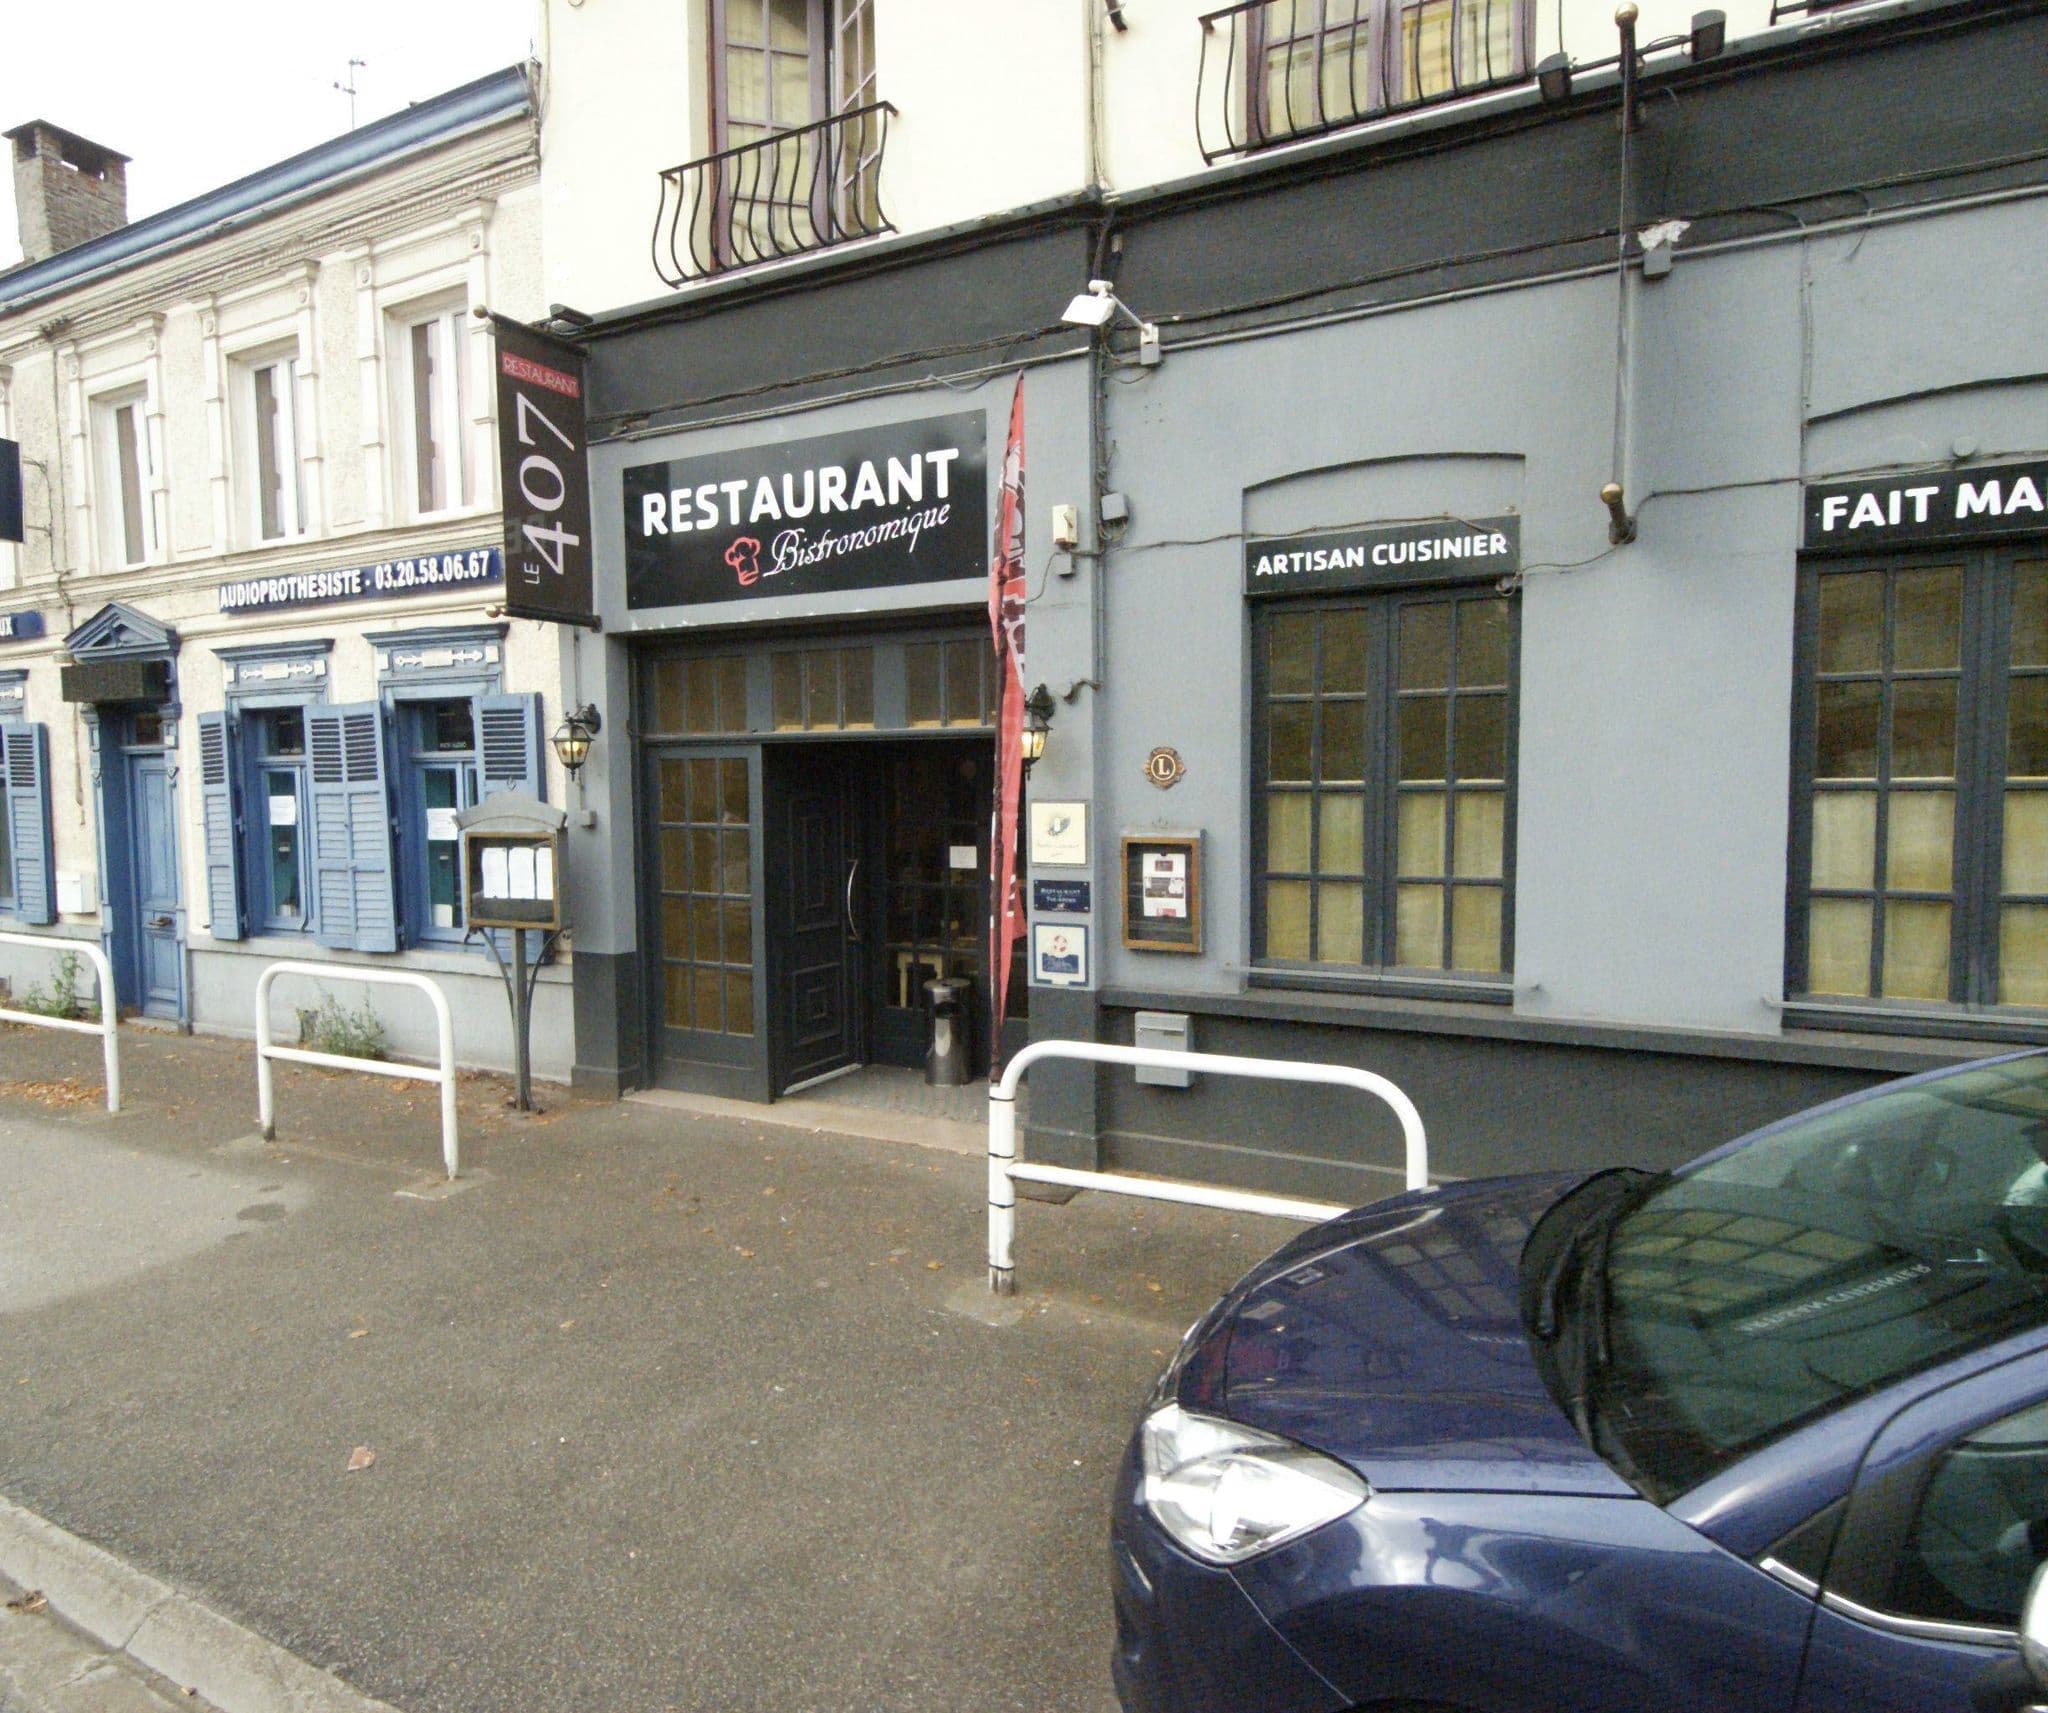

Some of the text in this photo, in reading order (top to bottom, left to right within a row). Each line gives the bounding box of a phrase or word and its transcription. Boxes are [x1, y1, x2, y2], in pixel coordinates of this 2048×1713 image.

[502, 355, 578, 393] RESTAURANT
[516, 391, 580, 584] LE 407
[642, 448, 959, 537] RESTAURANT
[1822, 476, 2045, 532] FAIT MA
[763, 503, 951, 578] Bistronomique
[1255, 533, 1509, 577] ARTISAN CUISINIER
[219, 569, 361, 608] AUDIOPROTHESISTE
[374, 550, 489, 591] 03.20.58.06.67
[1158, 758, 1171, 776] L
